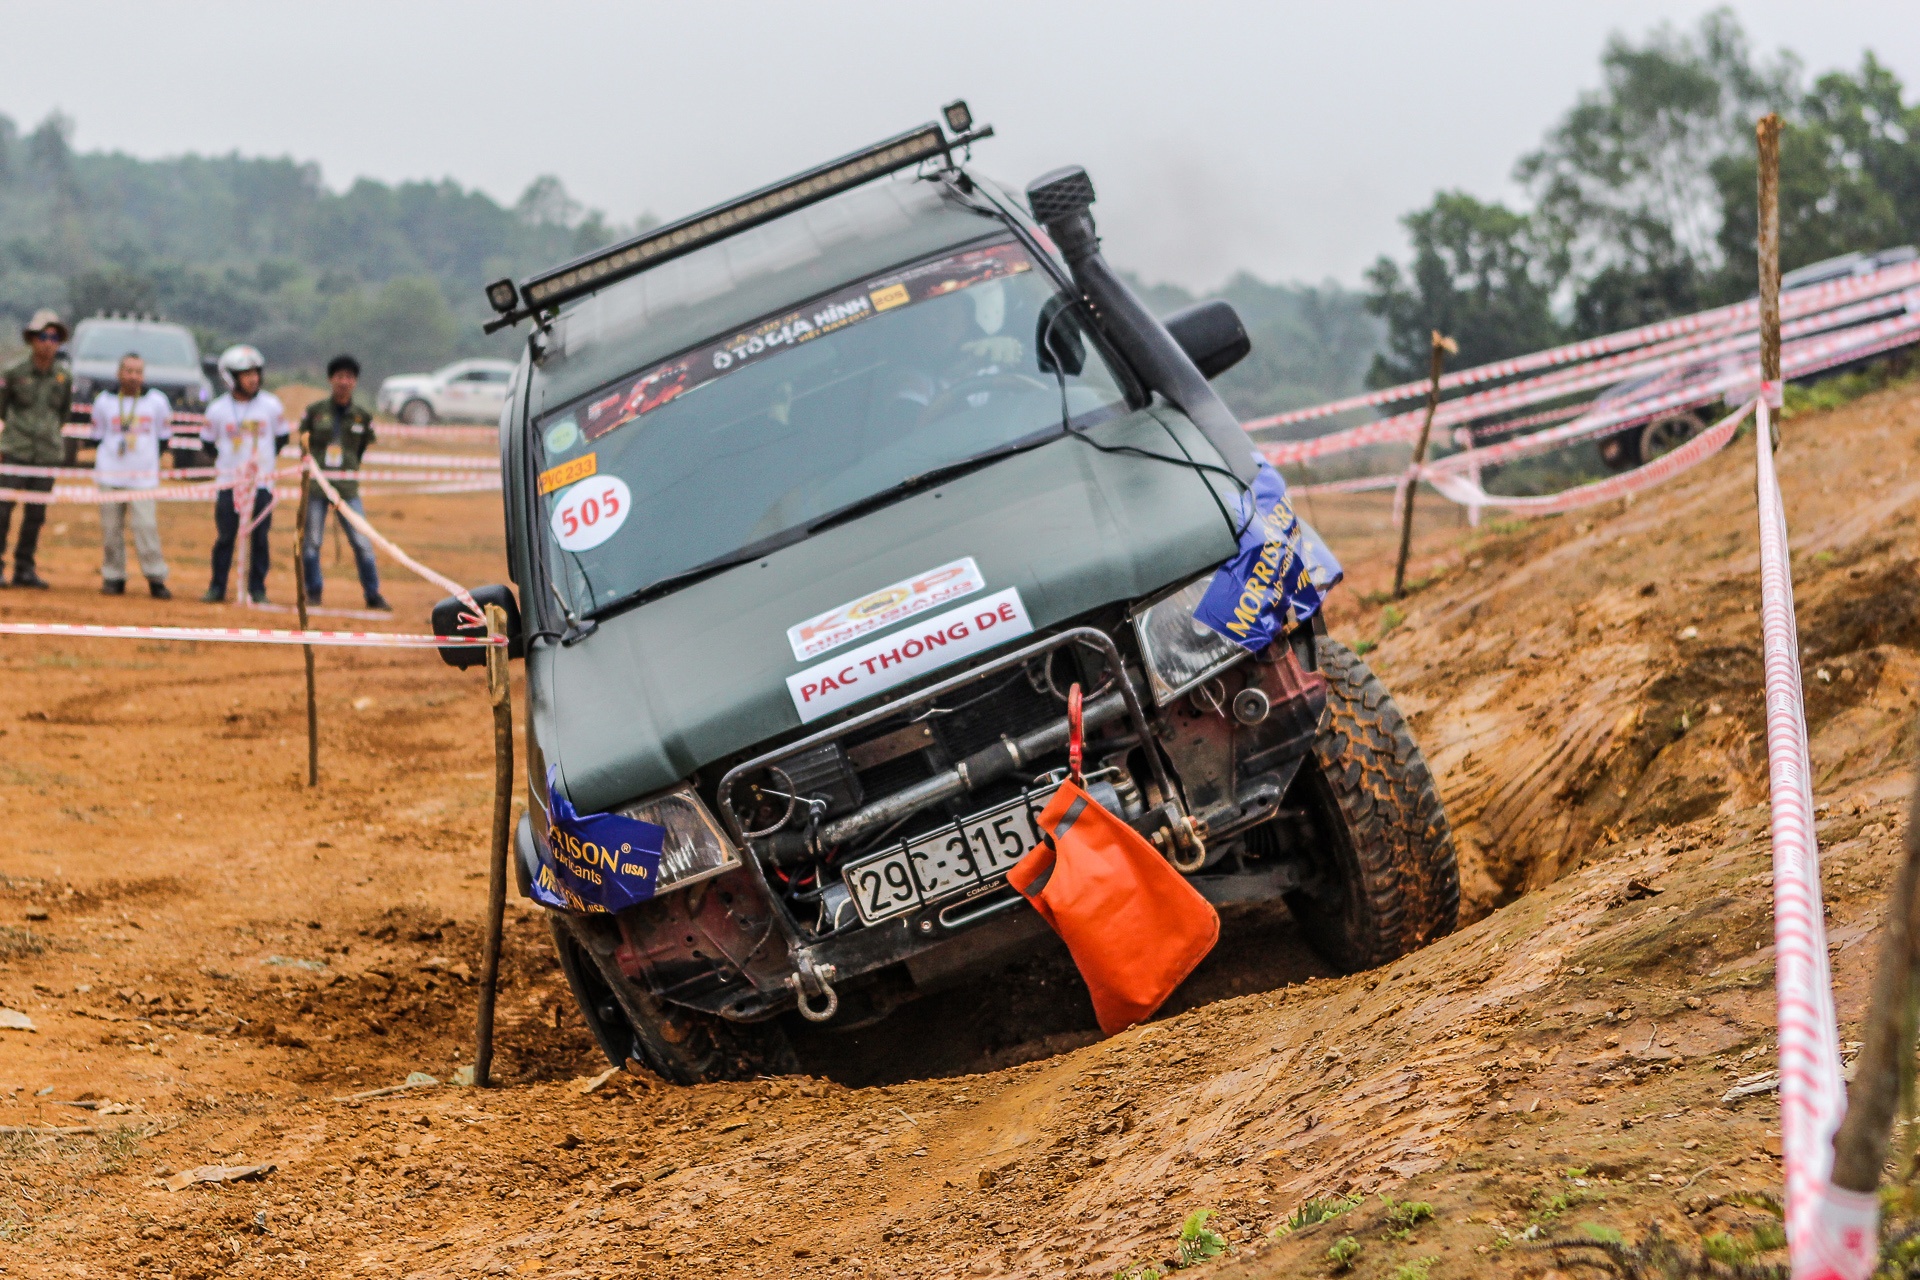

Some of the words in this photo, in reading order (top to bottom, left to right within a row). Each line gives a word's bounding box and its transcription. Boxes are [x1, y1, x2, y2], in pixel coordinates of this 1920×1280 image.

[566, 459, 593, 480] 233
[561, 488, 620, 538] 505
[801, 666, 858, 702] PAC
[859, 620, 970, 675] THÔNG
[974, 602, 1018, 631] DÊ
[621, 862, 648, 880] (USA)
